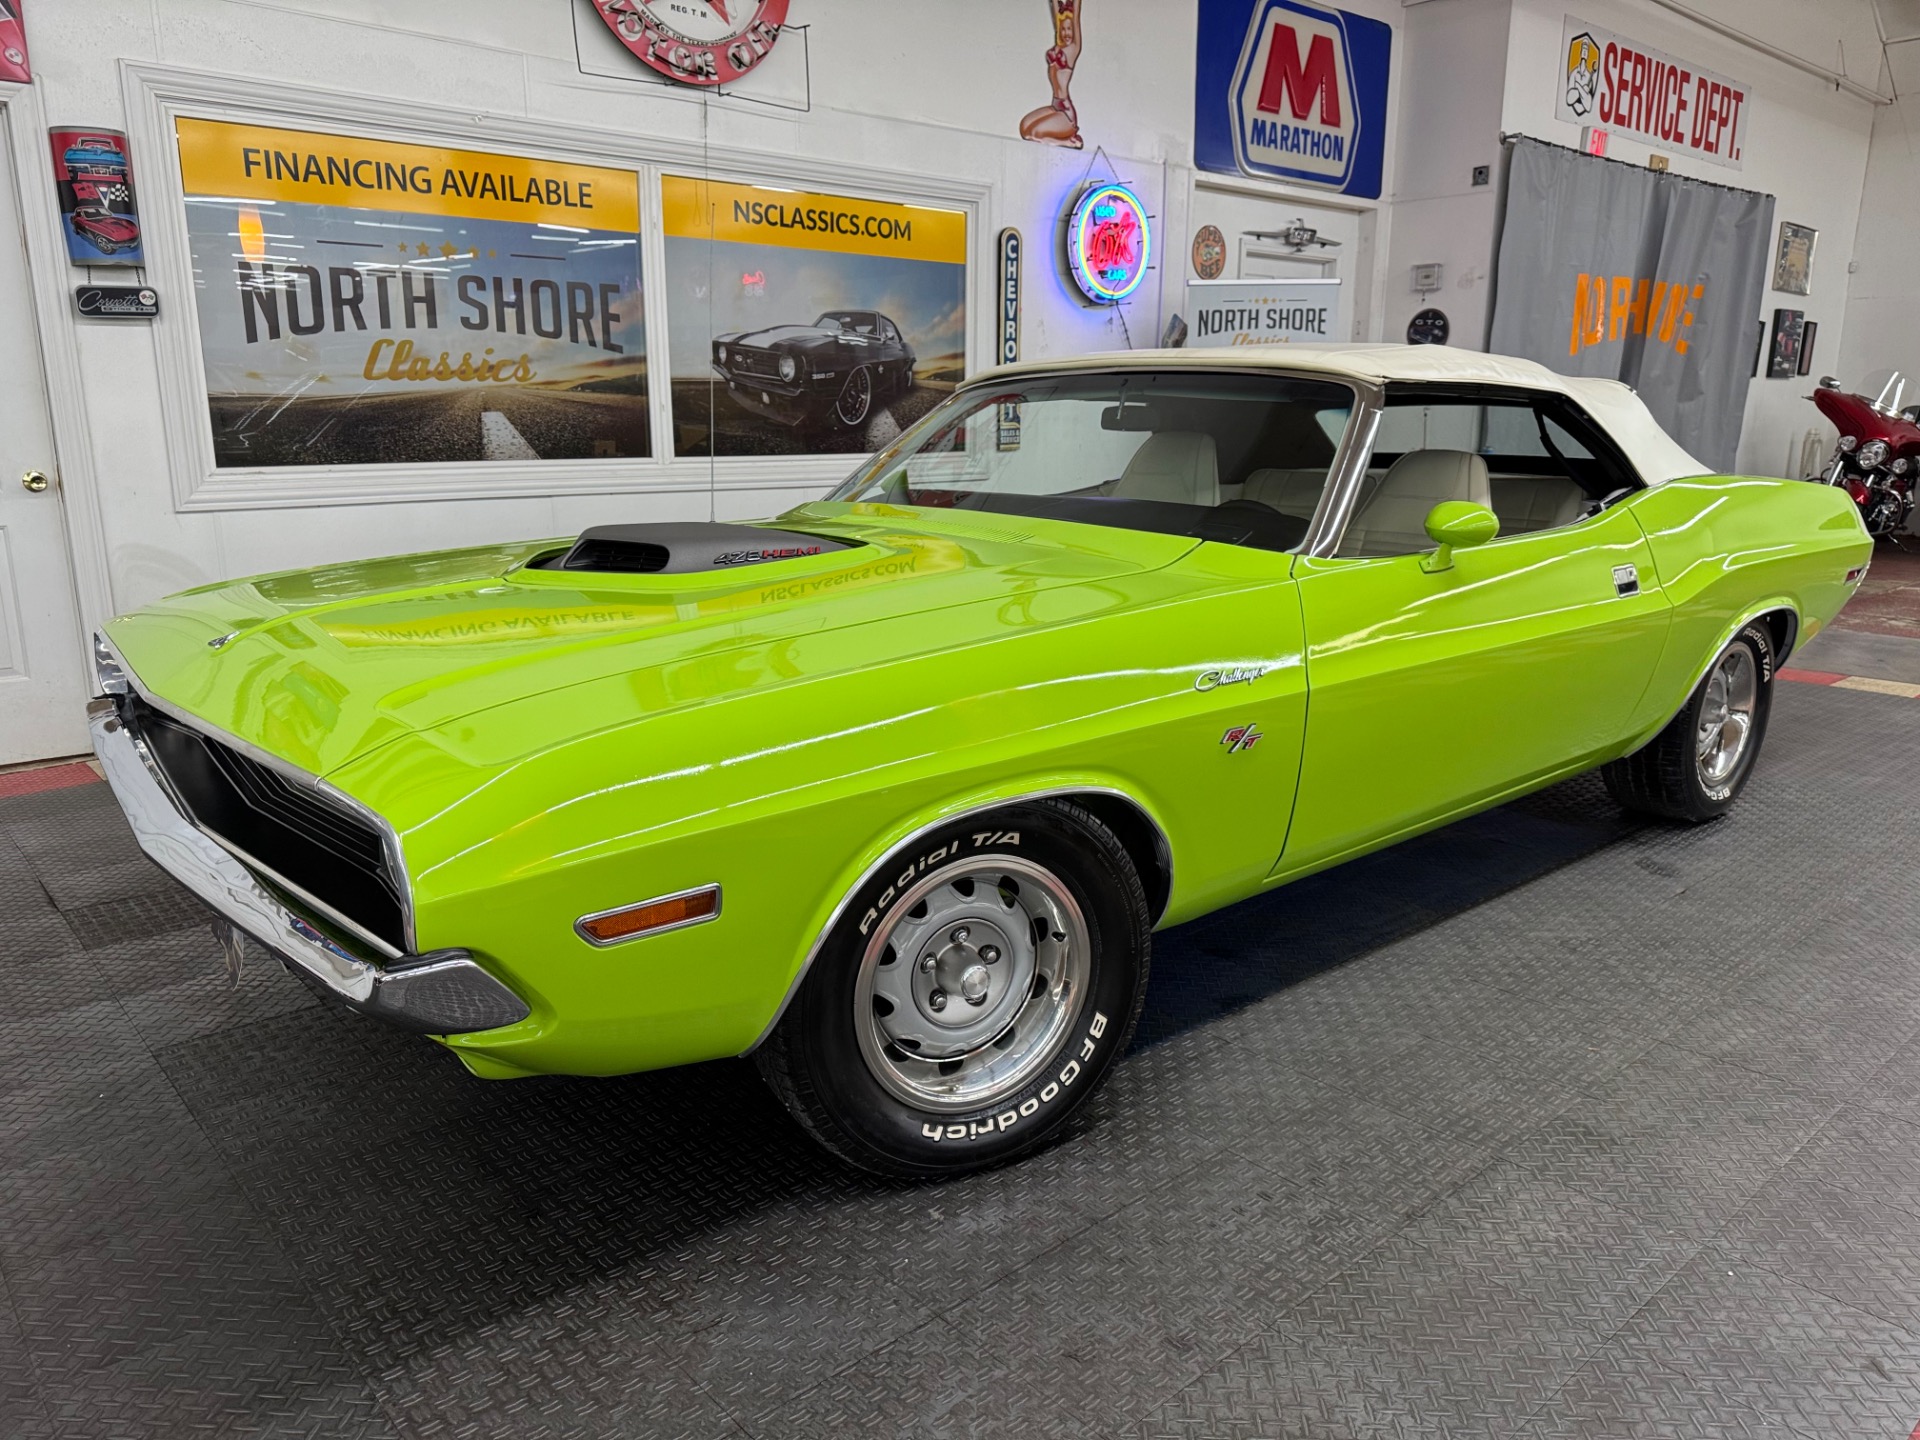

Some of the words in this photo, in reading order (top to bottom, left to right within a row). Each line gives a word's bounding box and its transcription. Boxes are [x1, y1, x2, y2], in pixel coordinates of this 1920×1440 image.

[1599, 41, 1691, 144] SERVICE
[1690, 76, 1745, 161] DEPT.
[1250, 118, 1344, 162] MARATHON
[243, 147, 432, 194] FINANCING
[441, 168, 594, 209] AVAILABLE
[733, 199, 912, 241] NSCLASSICS.COM
[1200, 259, 1220, 277] BEE
[79, 290, 140, 311] Corvette
[237, 261, 438, 344] NORTH
[457, 275, 624, 355] SHORE
[1197, 309, 1260, 337] NORTH
[1266, 308, 1328, 335] SHORE
[362, 338, 538, 383] Classics
[1194, 666, 1267, 692] Challenger
[1219, 723, 1264, 754] R/T
[859, 841, 959, 936] Radial
[972, 830, 1021, 848] T/A
